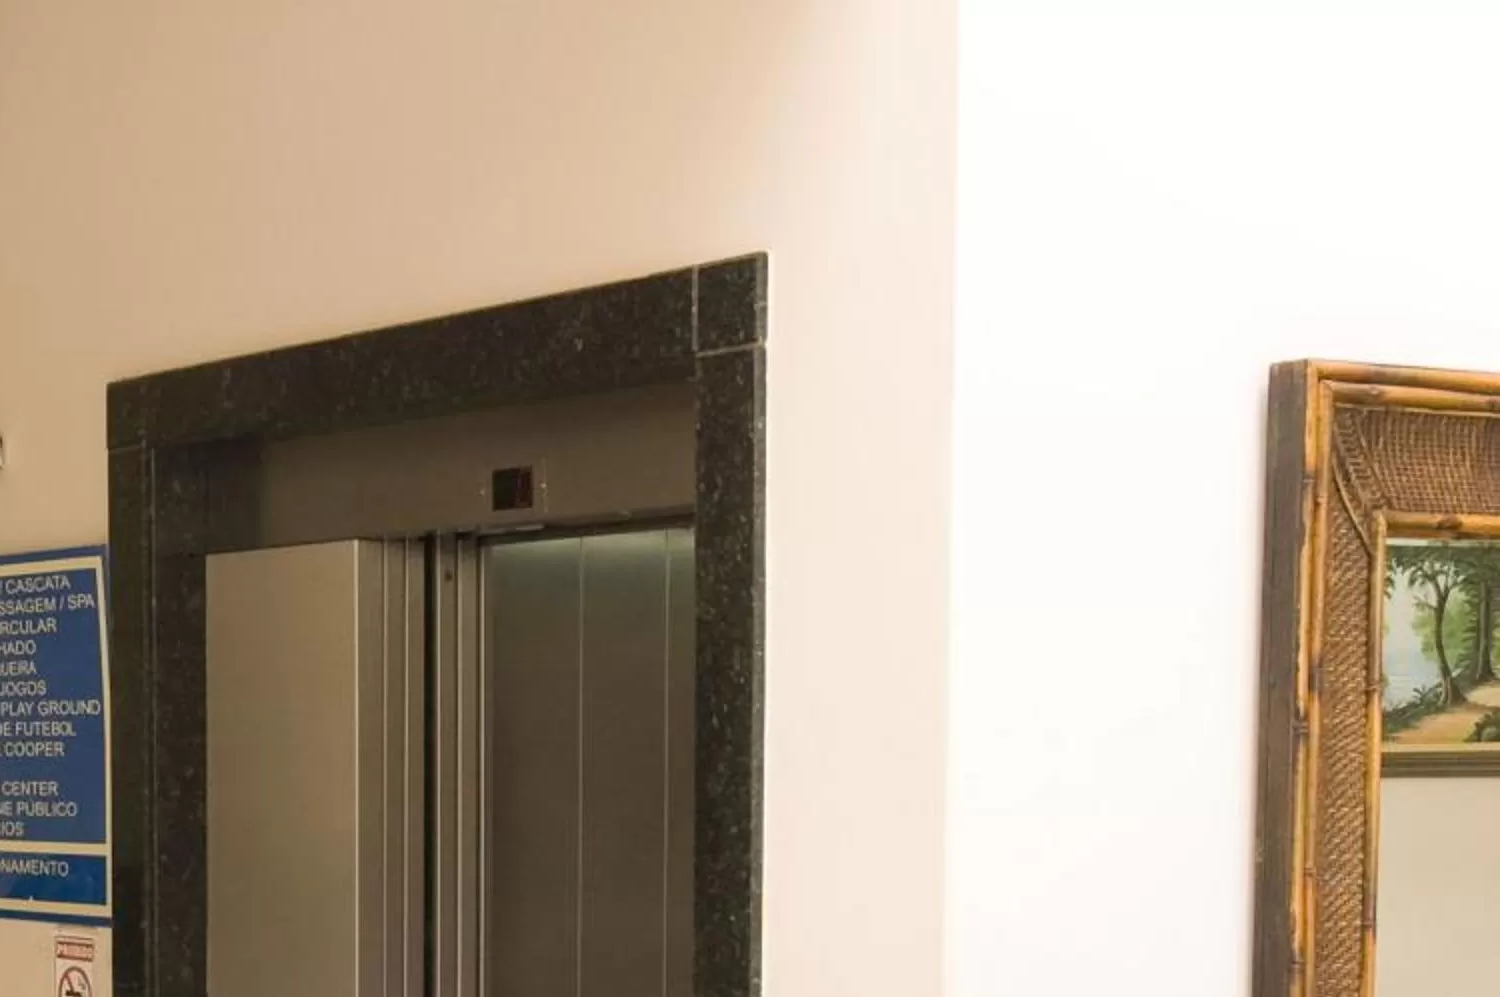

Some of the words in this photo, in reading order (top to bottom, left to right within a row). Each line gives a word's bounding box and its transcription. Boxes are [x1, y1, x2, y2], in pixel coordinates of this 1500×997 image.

[5, 575, 71, 593] CASCATA
[67, 593, 97, 610] SPA
[0, 701, 36, 717] PLAY
[37, 699, 101, 717] GROUND
[15, 720, 77, 737] FUTEBOL
[3, 740, 66, 757] COOPER
[1, 780, 59, 797] CENTER
